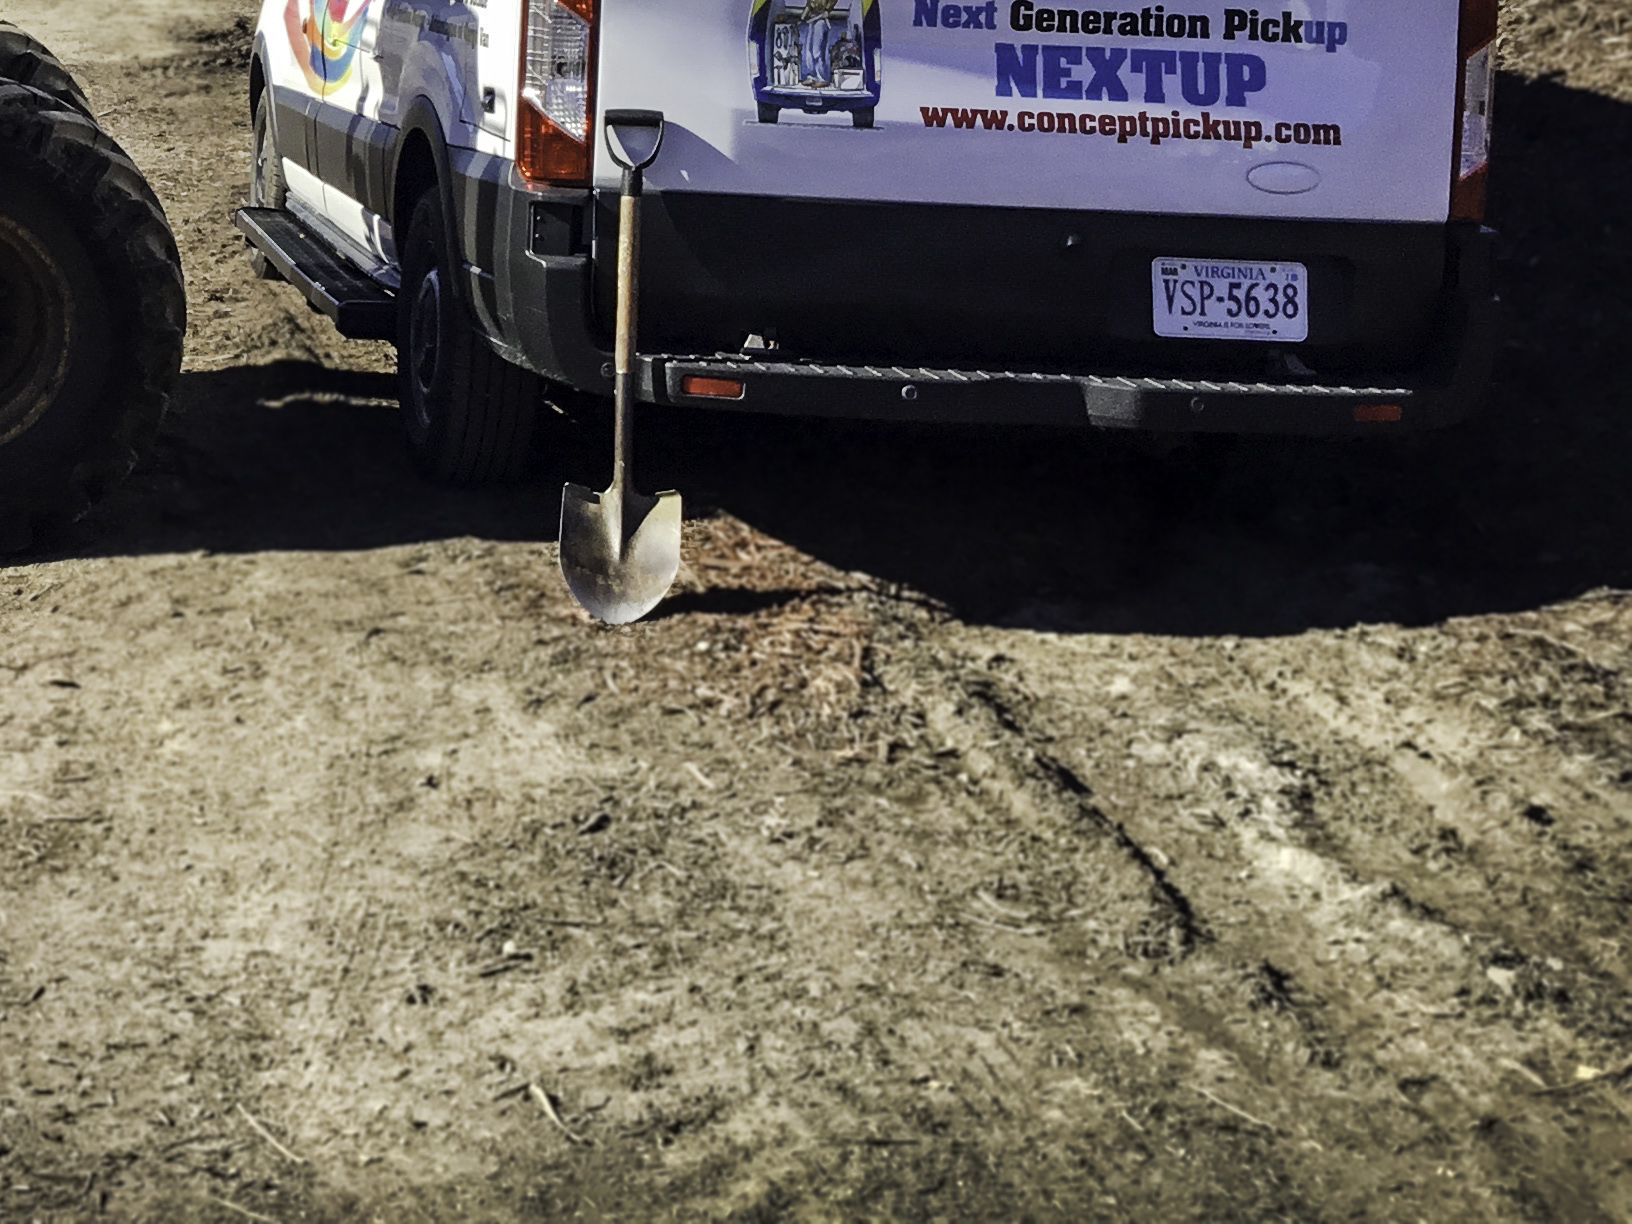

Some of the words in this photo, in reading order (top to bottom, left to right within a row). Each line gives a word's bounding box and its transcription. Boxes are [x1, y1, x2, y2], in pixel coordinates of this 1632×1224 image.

[1009, 0, 1210, 40] Generation
[1222, 8, 1348, 53] Pickup
[994, 42, 1267, 108] NEXTUP
[919, 106, 1342, 149] www.conceptpickup.com
[1193, 265, 1267, 281] VIRGINIA
[1163, 278, 1300, 319] VSP-5638
